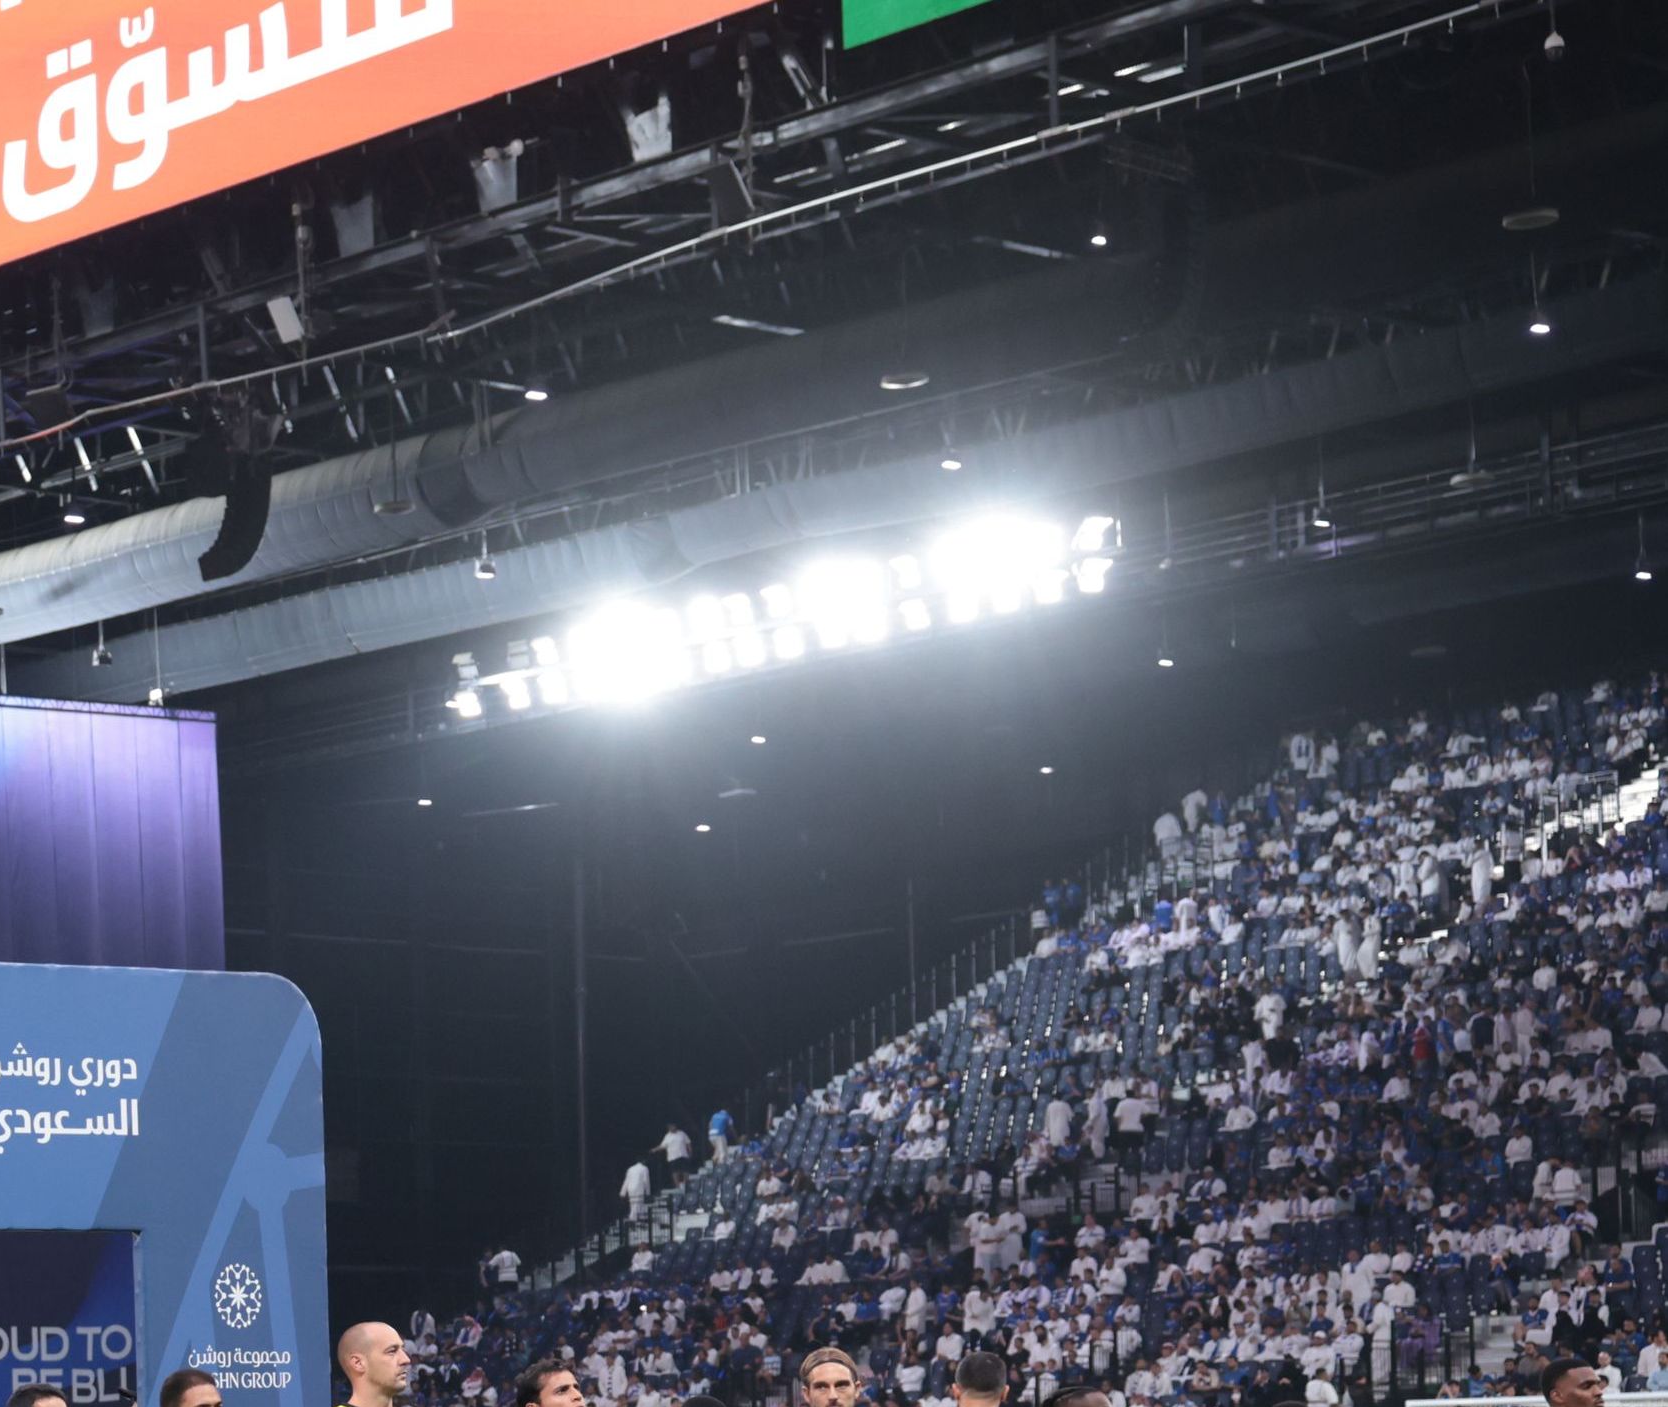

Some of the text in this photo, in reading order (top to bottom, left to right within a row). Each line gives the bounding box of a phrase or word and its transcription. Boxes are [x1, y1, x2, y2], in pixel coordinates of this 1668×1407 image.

[67, 1057, 138, 1097] دوري
[76, 1325, 133, 1360] TO
[188, 1346, 291, 1368] مجموعة روشن
[242, 1371, 291, 1388] GROUP
